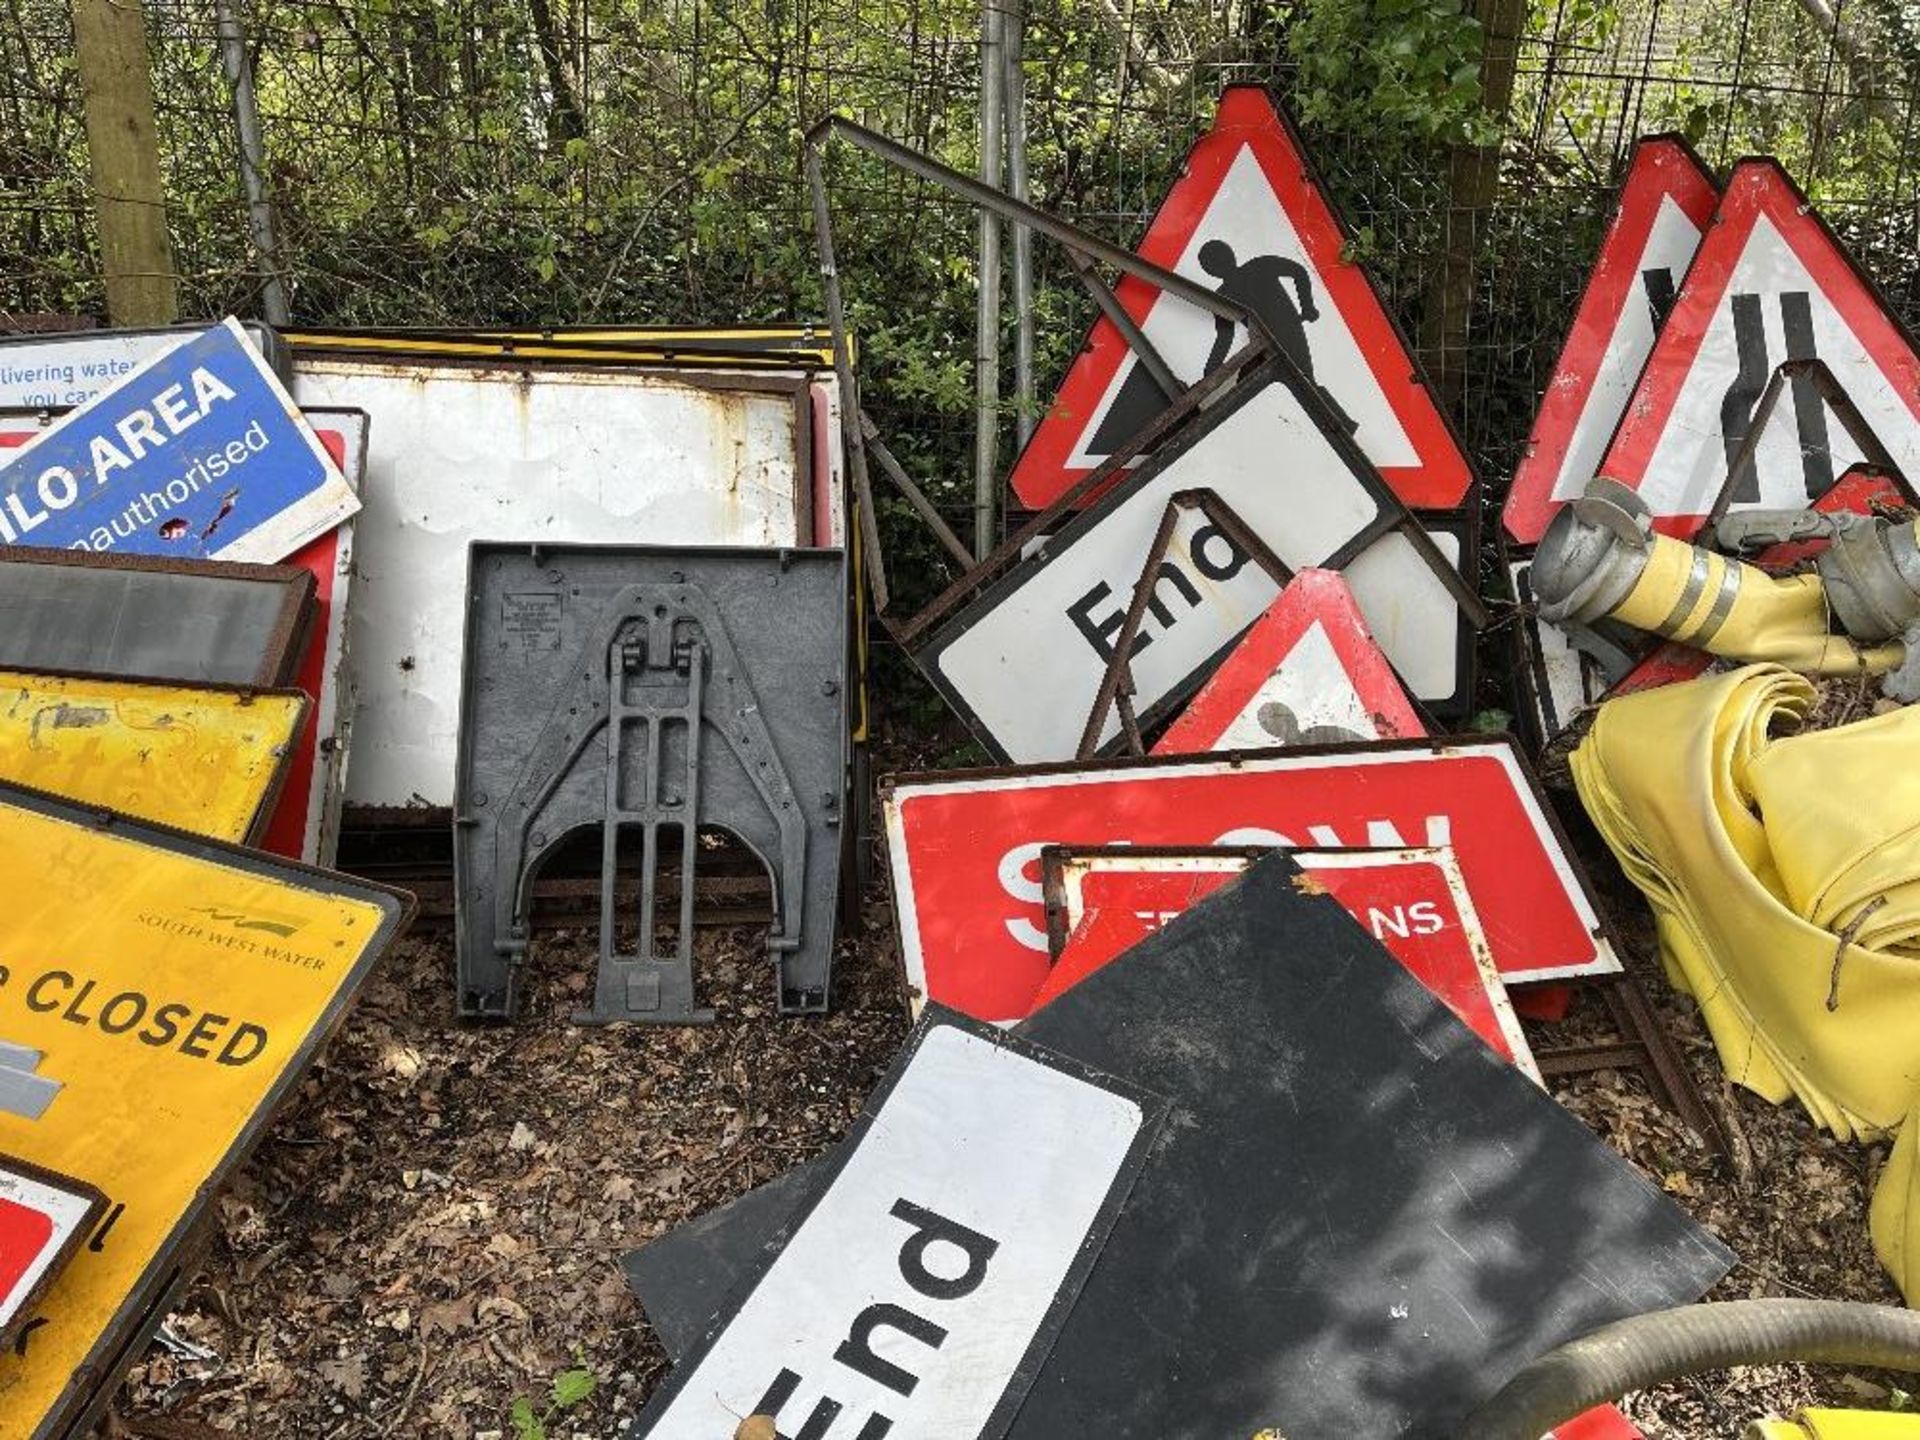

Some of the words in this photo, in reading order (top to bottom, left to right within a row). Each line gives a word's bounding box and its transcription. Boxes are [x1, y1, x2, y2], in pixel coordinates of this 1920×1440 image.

[23, 392, 57, 407] you
[89, 366, 237, 485] AREA
[1065, 523, 1253, 665] End
[135, 911, 203, 939] SOUTH
[208, 931, 258, 953] WEST
[264, 945, 326, 971] WATER
[26, 970, 268, 1067] CLOSED
[745, 1197, 1000, 1440] End
